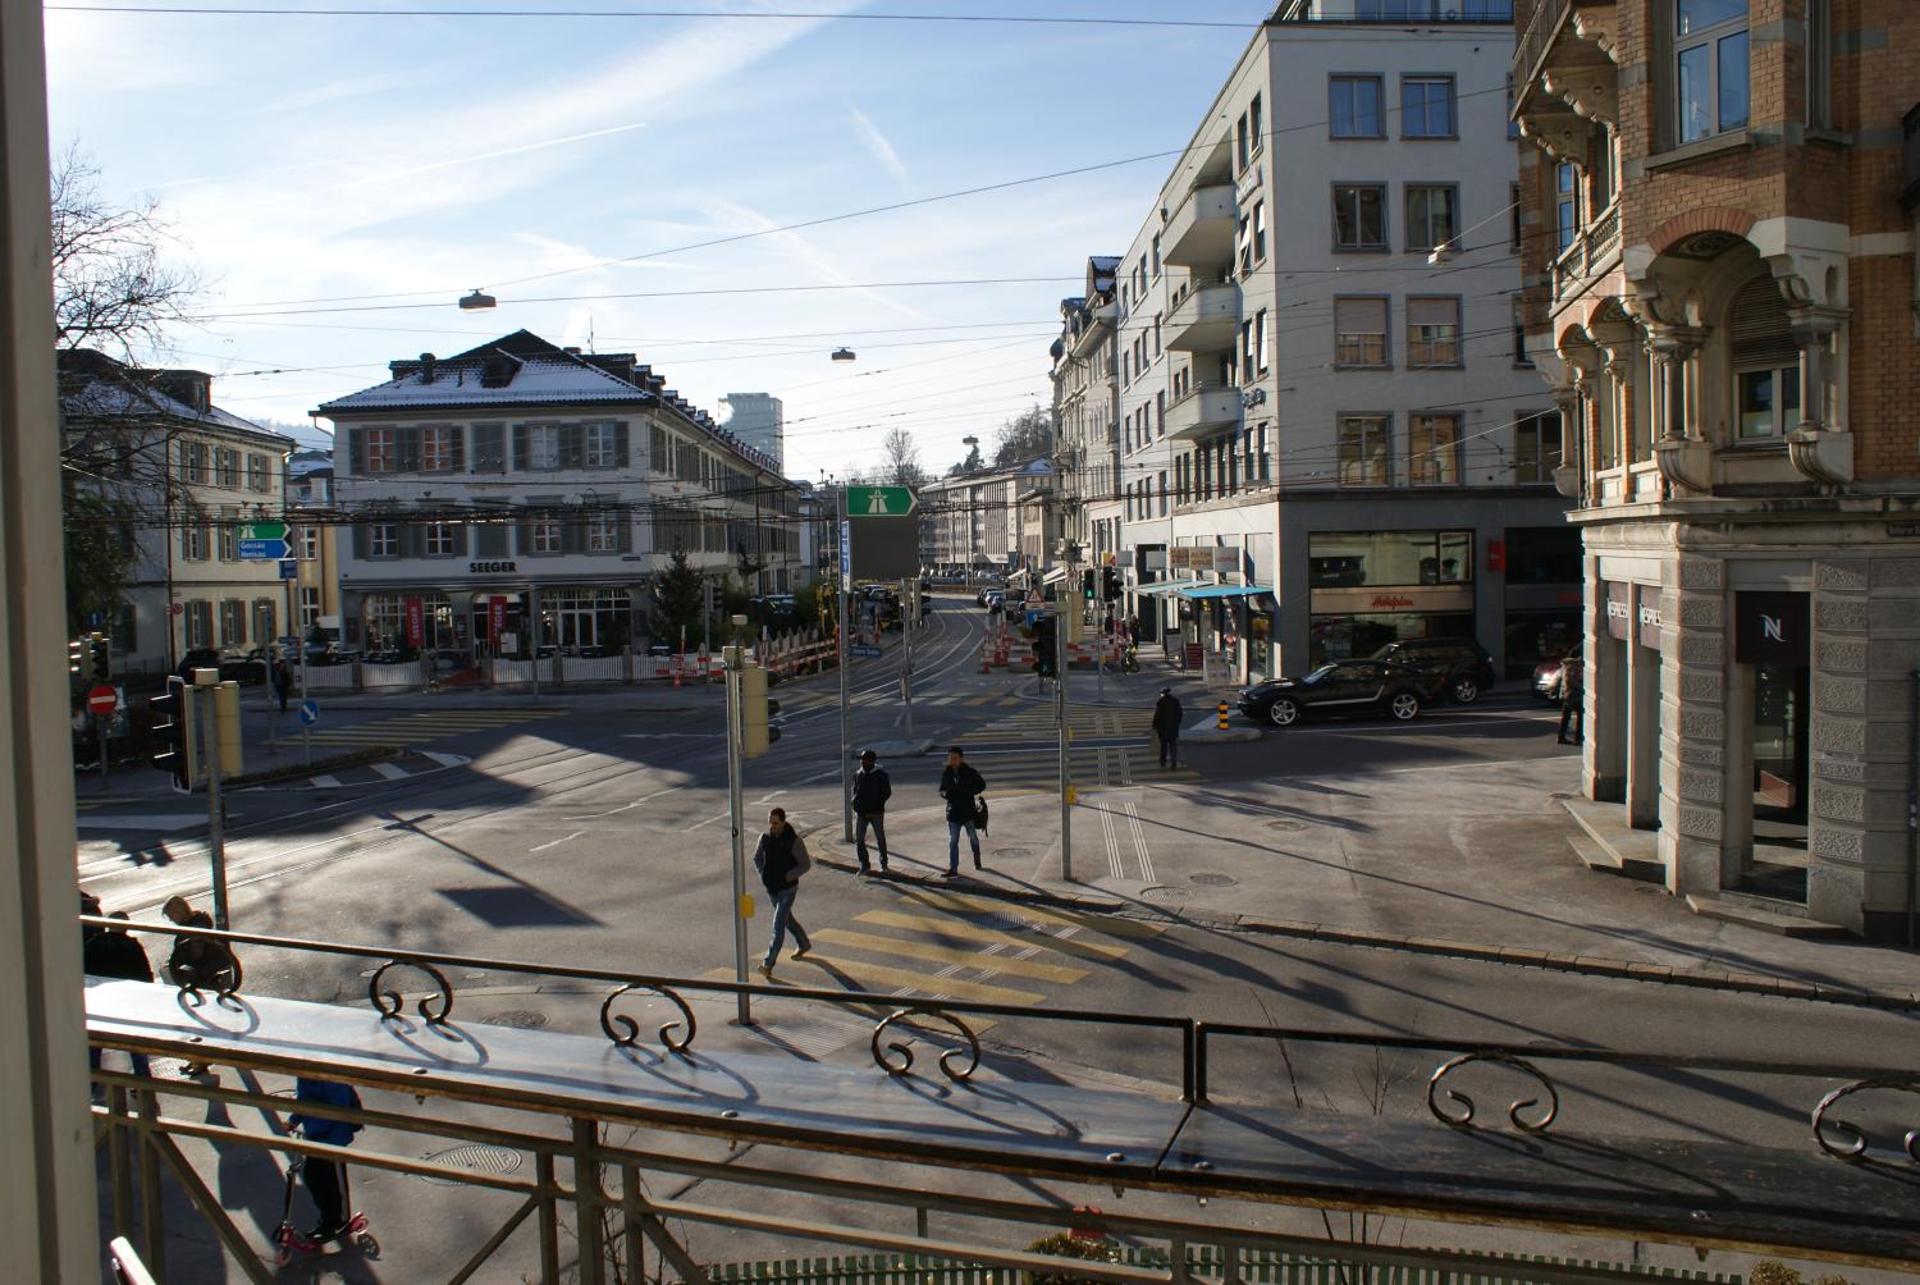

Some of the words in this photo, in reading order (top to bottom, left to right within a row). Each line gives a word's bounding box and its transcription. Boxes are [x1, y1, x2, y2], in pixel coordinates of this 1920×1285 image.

[469, 561, 517, 573] SEEGER
[410, 606, 420, 640] SEEGER
[1758, 613, 1788, 643] N
